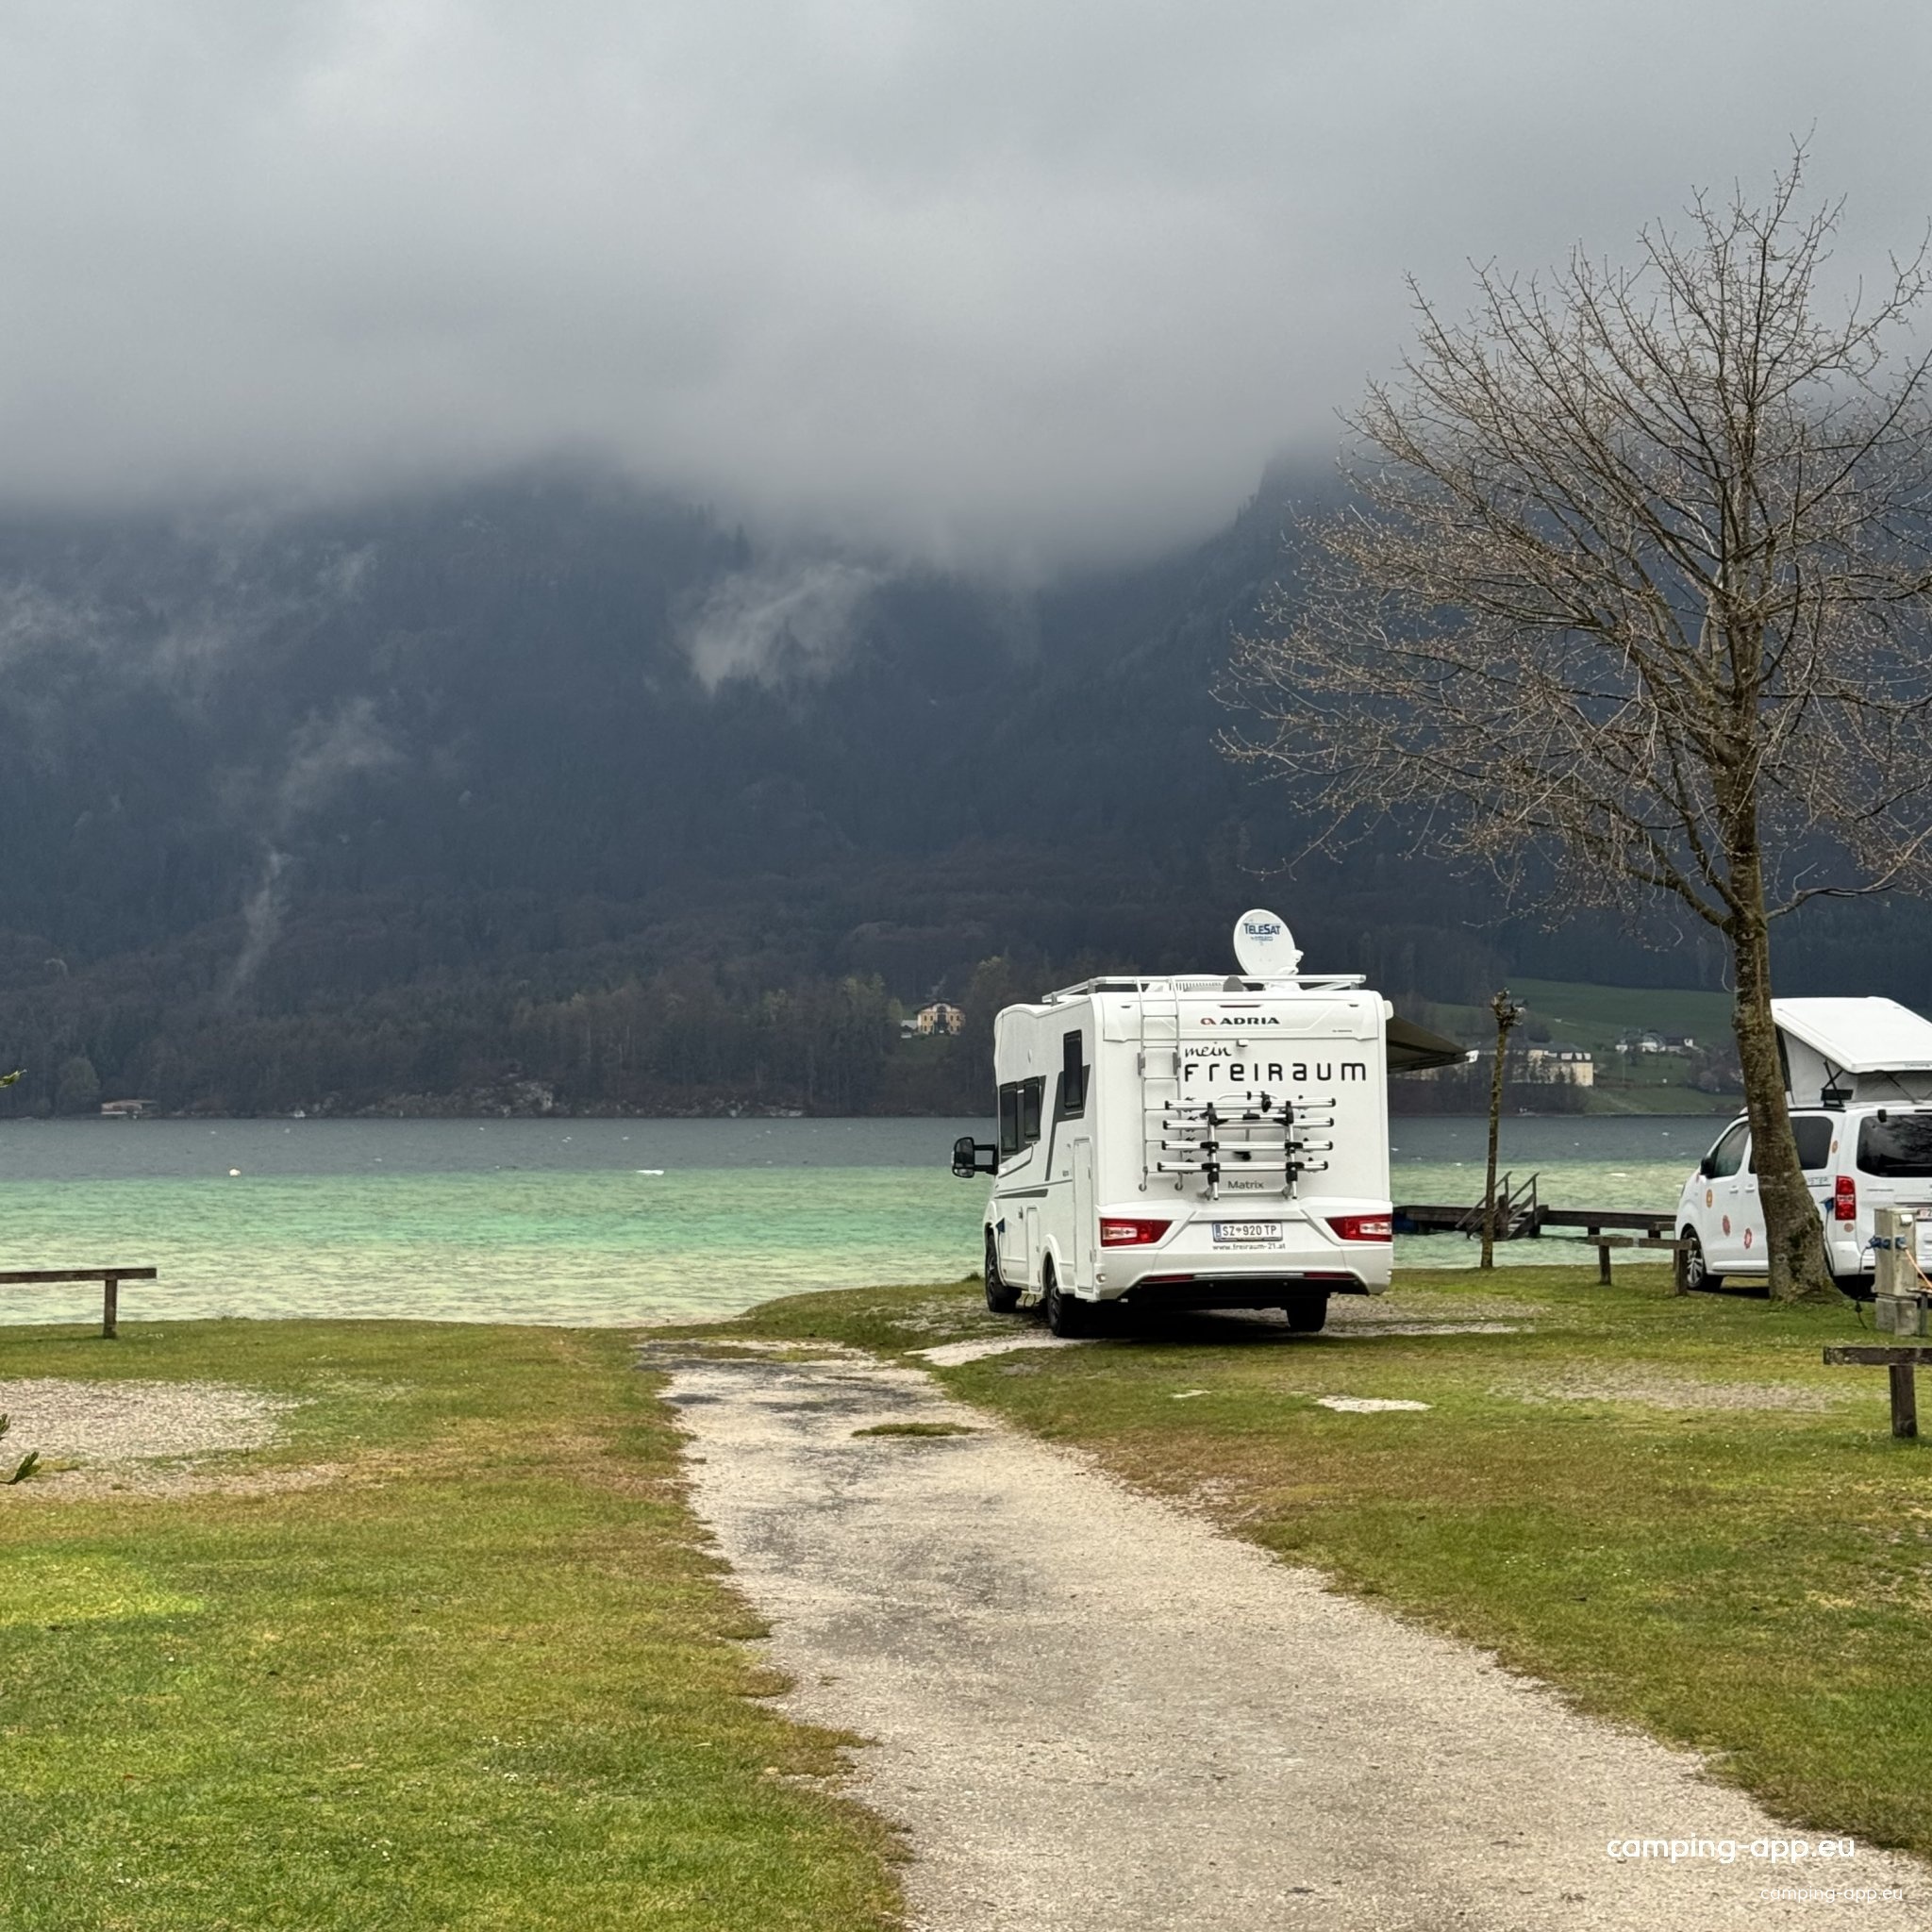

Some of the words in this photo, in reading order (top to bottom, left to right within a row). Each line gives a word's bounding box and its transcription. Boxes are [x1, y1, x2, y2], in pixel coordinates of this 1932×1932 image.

[1220, 1017, 1280, 1025] ADRIA
[1185, 1041, 1232, 1058] mein
[1227, 1180, 1264, 1190] Matrix
[1212, 1242, 1286, 1251] www.freiraum-21.at
